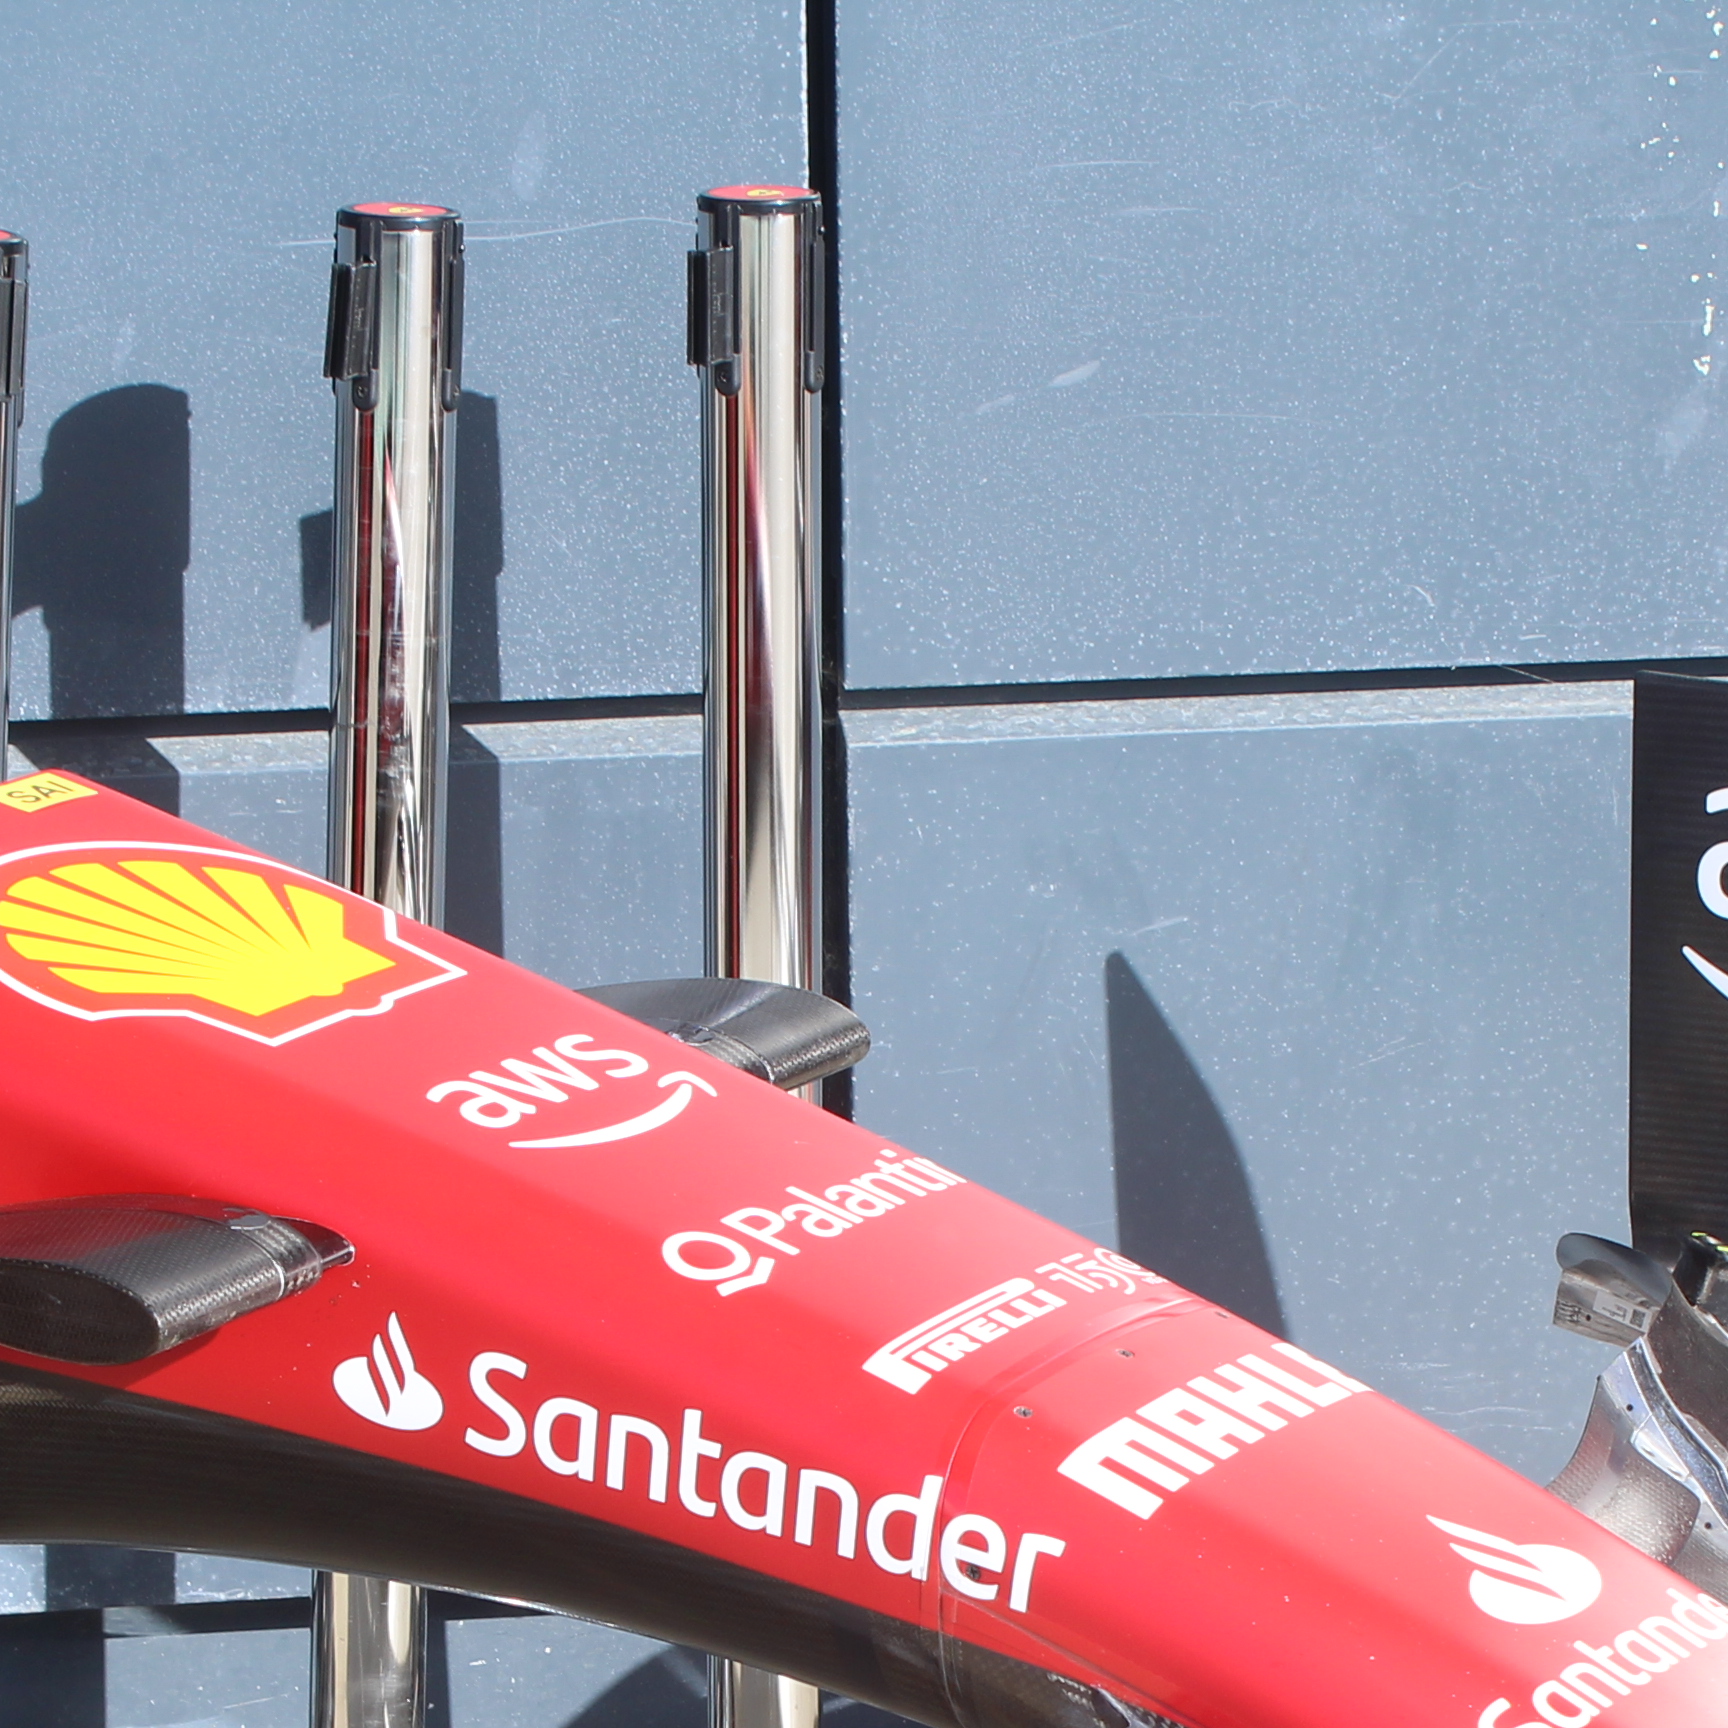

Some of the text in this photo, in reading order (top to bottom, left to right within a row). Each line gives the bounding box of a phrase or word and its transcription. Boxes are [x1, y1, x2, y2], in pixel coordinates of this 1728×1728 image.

[6, 780, 74, 804] SAI
[426, 1034, 650, 1128] aws
[861, 1277, 1067, 1395] PIRELLI
[464, 1351, 1066, 1614] Santander
